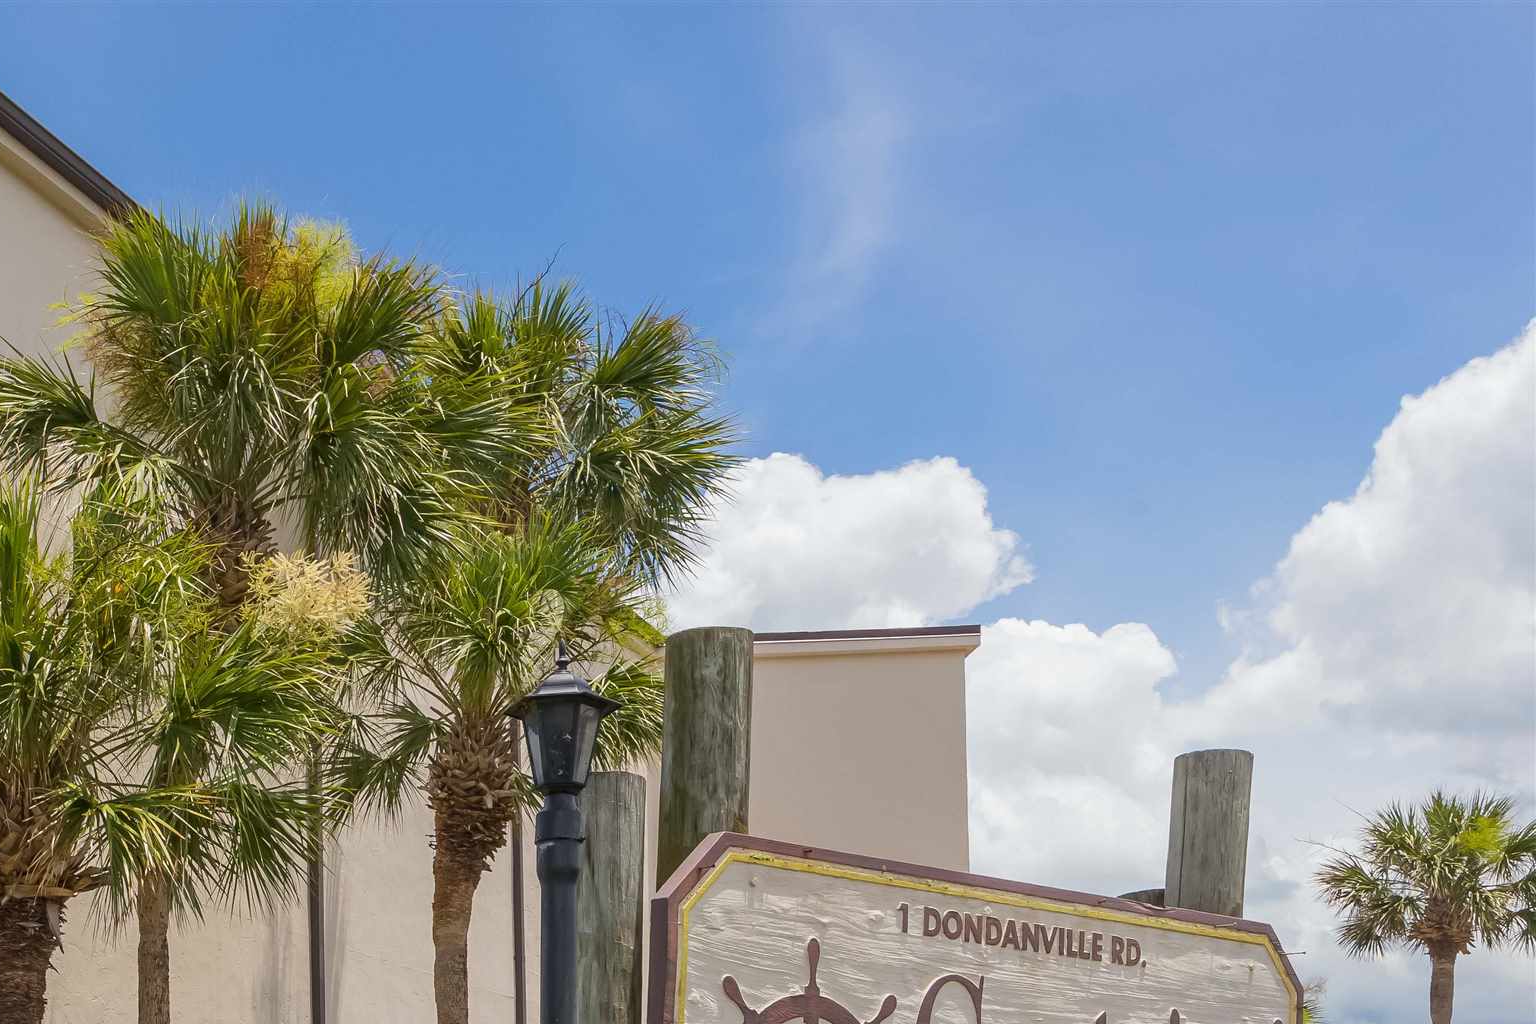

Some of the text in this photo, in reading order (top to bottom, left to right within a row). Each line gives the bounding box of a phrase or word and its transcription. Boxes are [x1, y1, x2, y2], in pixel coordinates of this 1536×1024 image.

[896, 903, 1148, 968] 1 DONDANVILLE RD.
